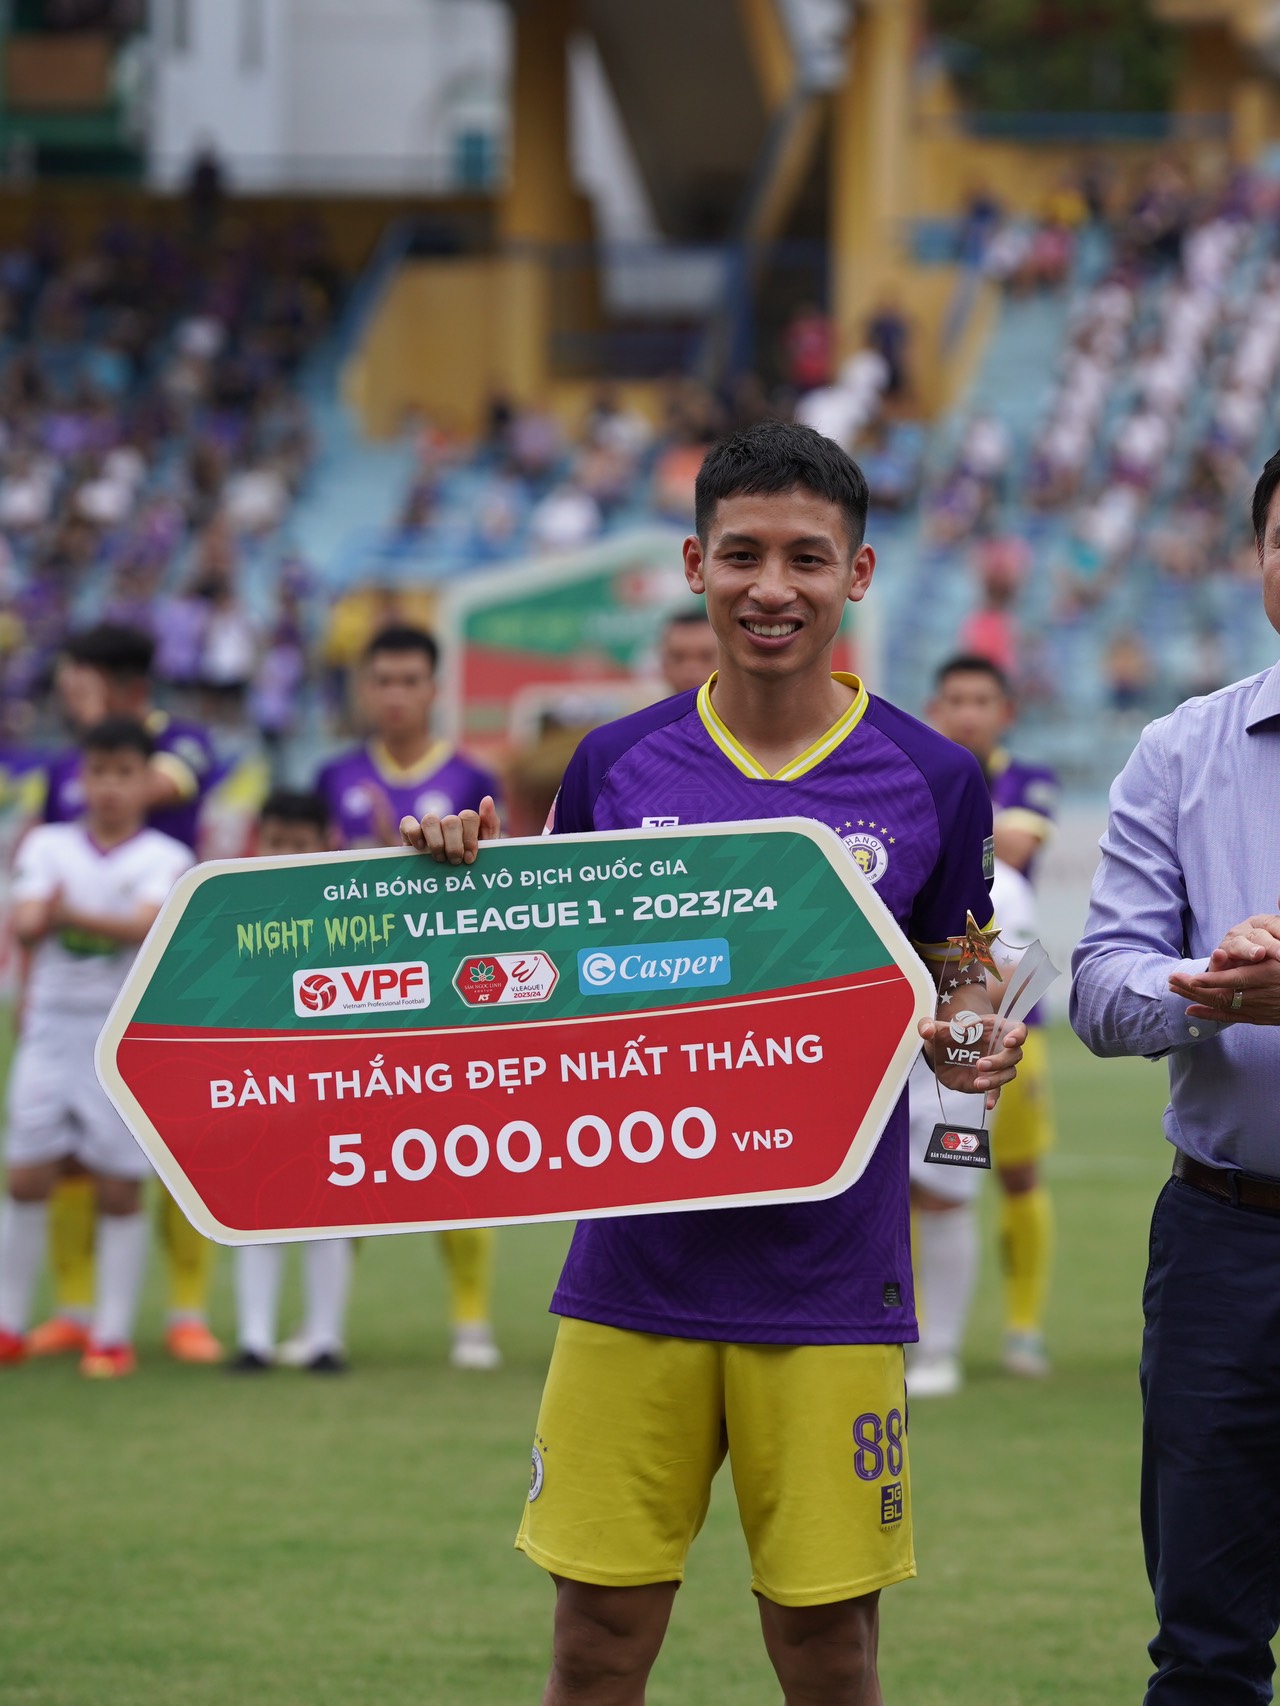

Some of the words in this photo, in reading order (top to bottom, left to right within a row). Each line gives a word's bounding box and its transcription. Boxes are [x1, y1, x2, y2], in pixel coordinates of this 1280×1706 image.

[845, 836, 882, 852] HANOI
[323, 878, 368, 901] GIẢI
[375, 875, 438, 898] BÓNG
[445, 871, 476, 892] ĐÁ
[481, 867, 513, 889] VÔ
[520, 867, 572, 890] ĐỊCH
[579, 856, 643, 882] QUỐC
[649, 859, 688, 876] GIA
[236, 916, 314, 959] NIGHT
[324, 913, 396, 957] WOLF
[403, 901, 579, 938] V.LEAGUE
[588, 899, 607, 924] 1
[632, 886, 778, 921] 2023/24
[341, 966, 424, 1002] VPF
[619, 952, 724, 984] Casper
[367, 1000, 401, 1008] Professional
[209, 1068, 296, 1109] BÀN
[308, 1053, 453, 1100] THẮNG
[465, 1056, 547, 1094] ĐẸP
[560, 1034, 668, 1082] NHẤT
[680, 1030, 824, 1073] THÁNG
[946, 1047, 981, 1063] VPF
[327, 1106, 717, 1187] 5.000.000
[731, 1128, 794, 1152] VNĐ
[852, 1408, 903, 1481] 88
